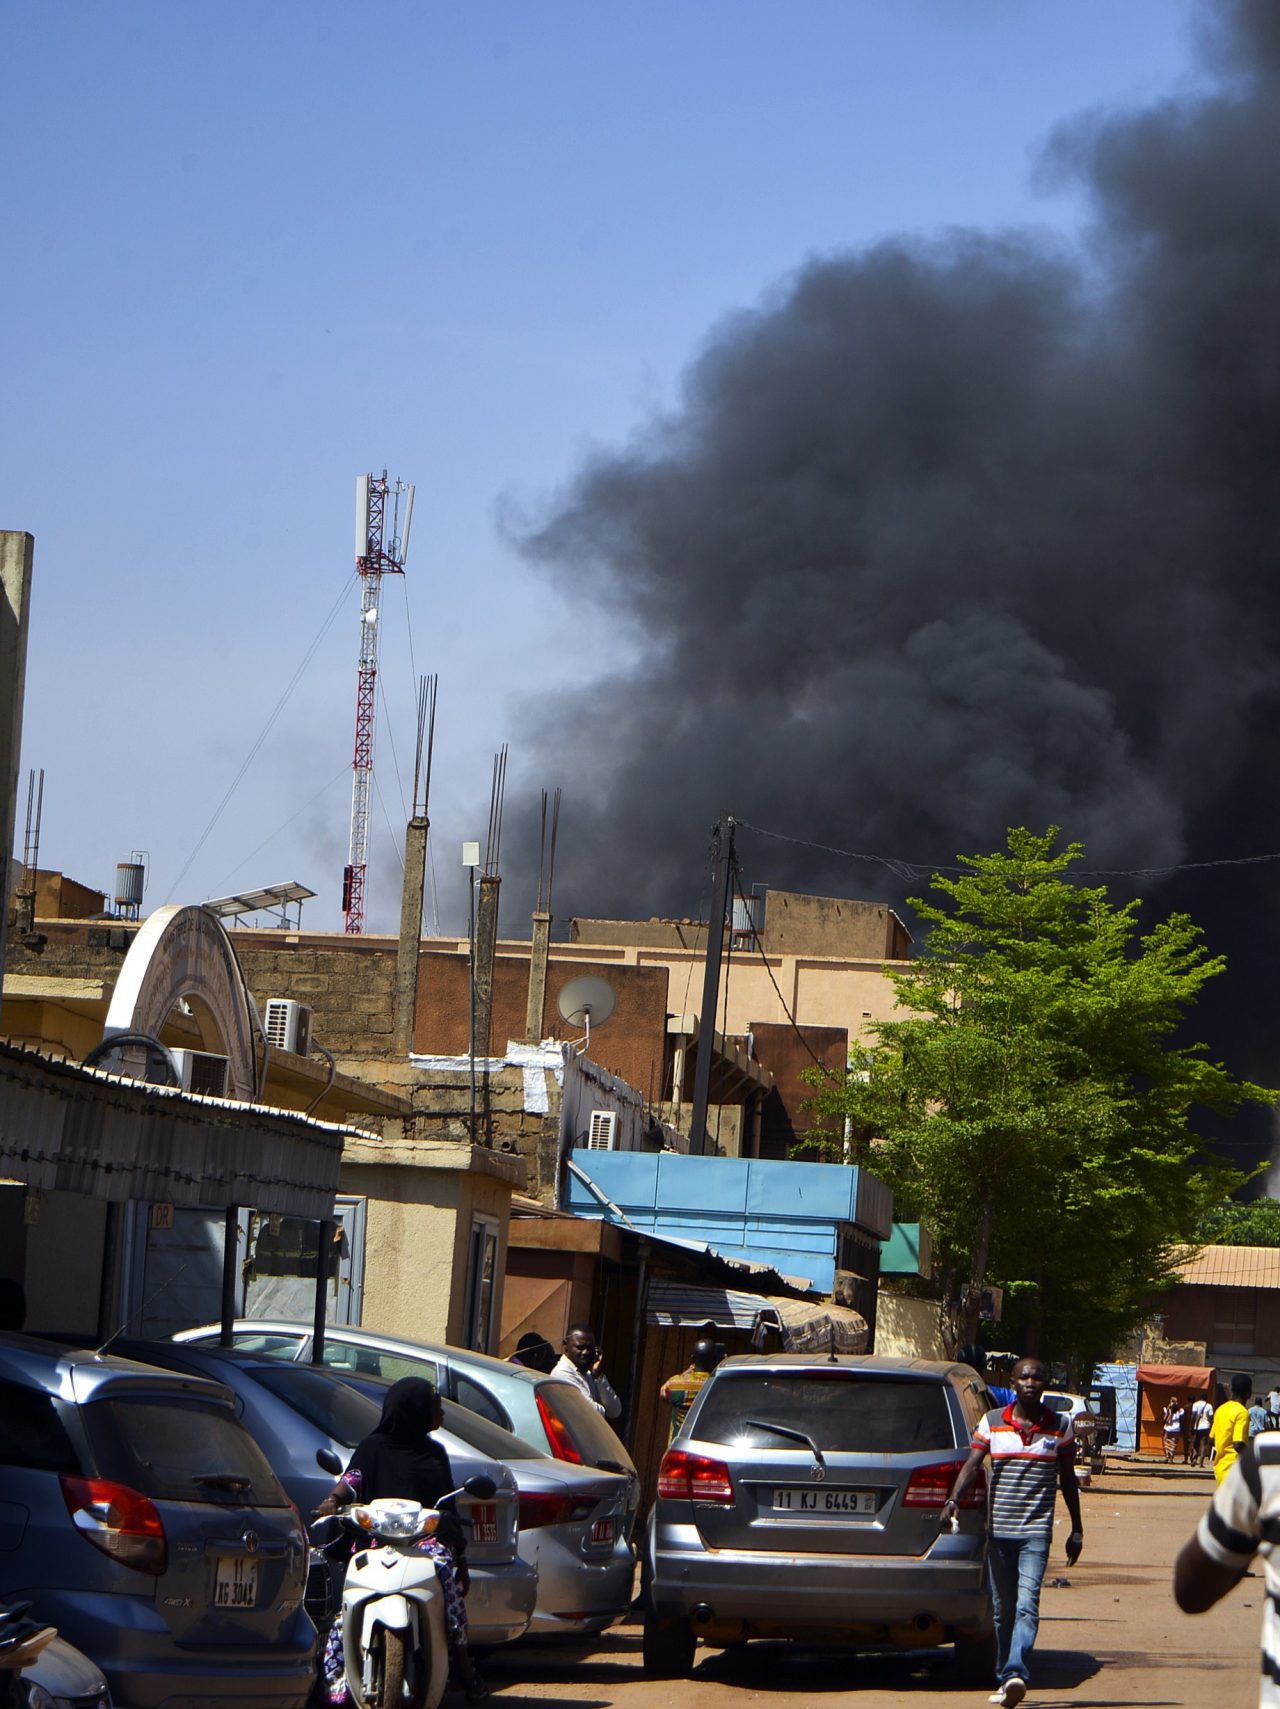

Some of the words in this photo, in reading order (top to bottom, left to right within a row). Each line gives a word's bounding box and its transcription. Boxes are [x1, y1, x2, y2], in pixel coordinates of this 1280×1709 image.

[777, 1492, 791, 1508] 11
[801, 1493, 817, 1509] KJ
[825, 1493, 858, 1510] 6449
[234, 1559, 244, 1581] 11
